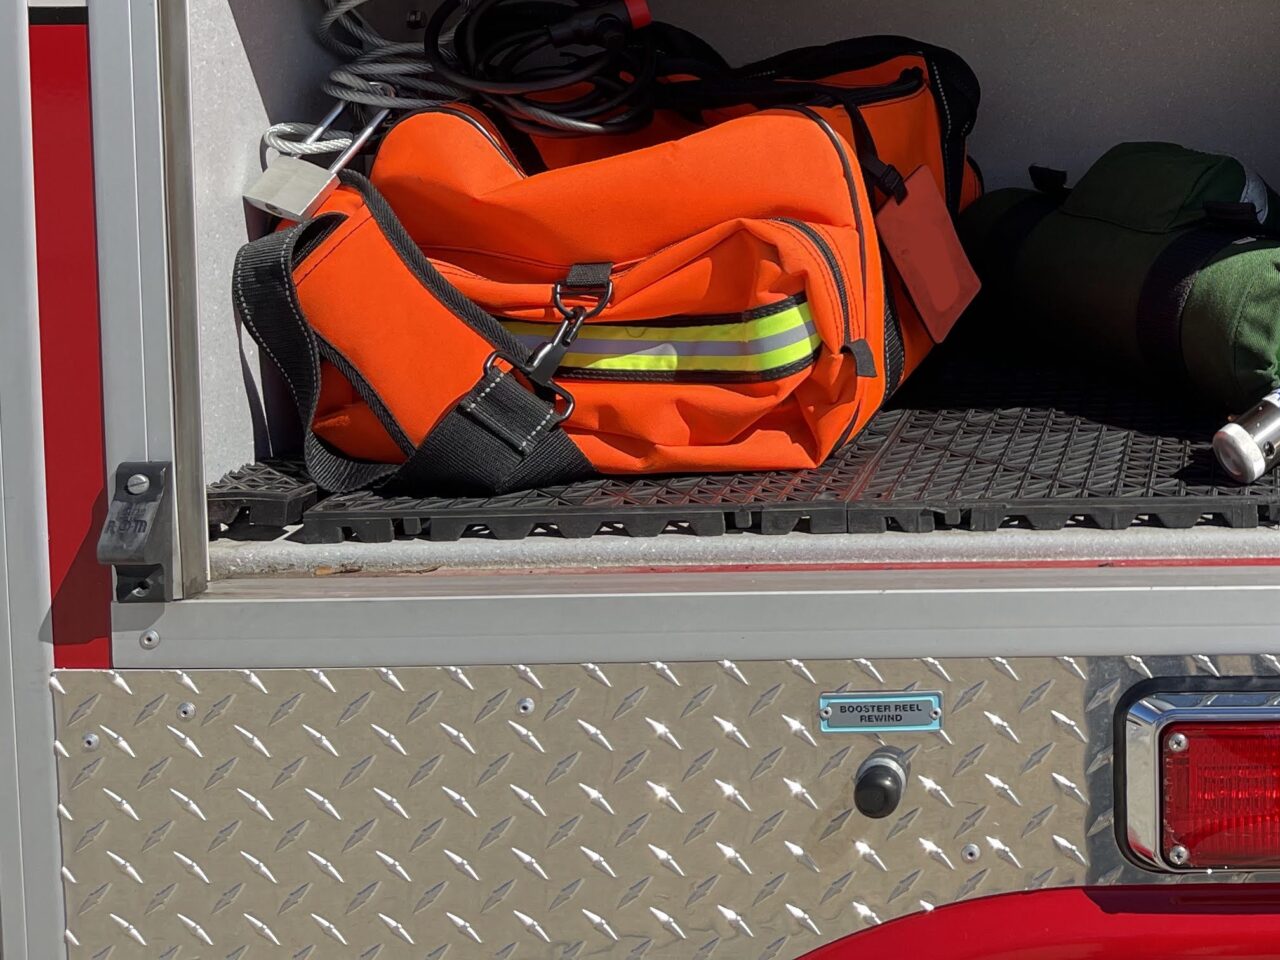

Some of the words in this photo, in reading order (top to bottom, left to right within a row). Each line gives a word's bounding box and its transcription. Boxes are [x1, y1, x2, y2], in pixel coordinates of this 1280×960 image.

[839, 704, 892, 713] BOOSTER
[895, 703, 923, 712] REEL
[859, 714, 903, 723] REWIND
